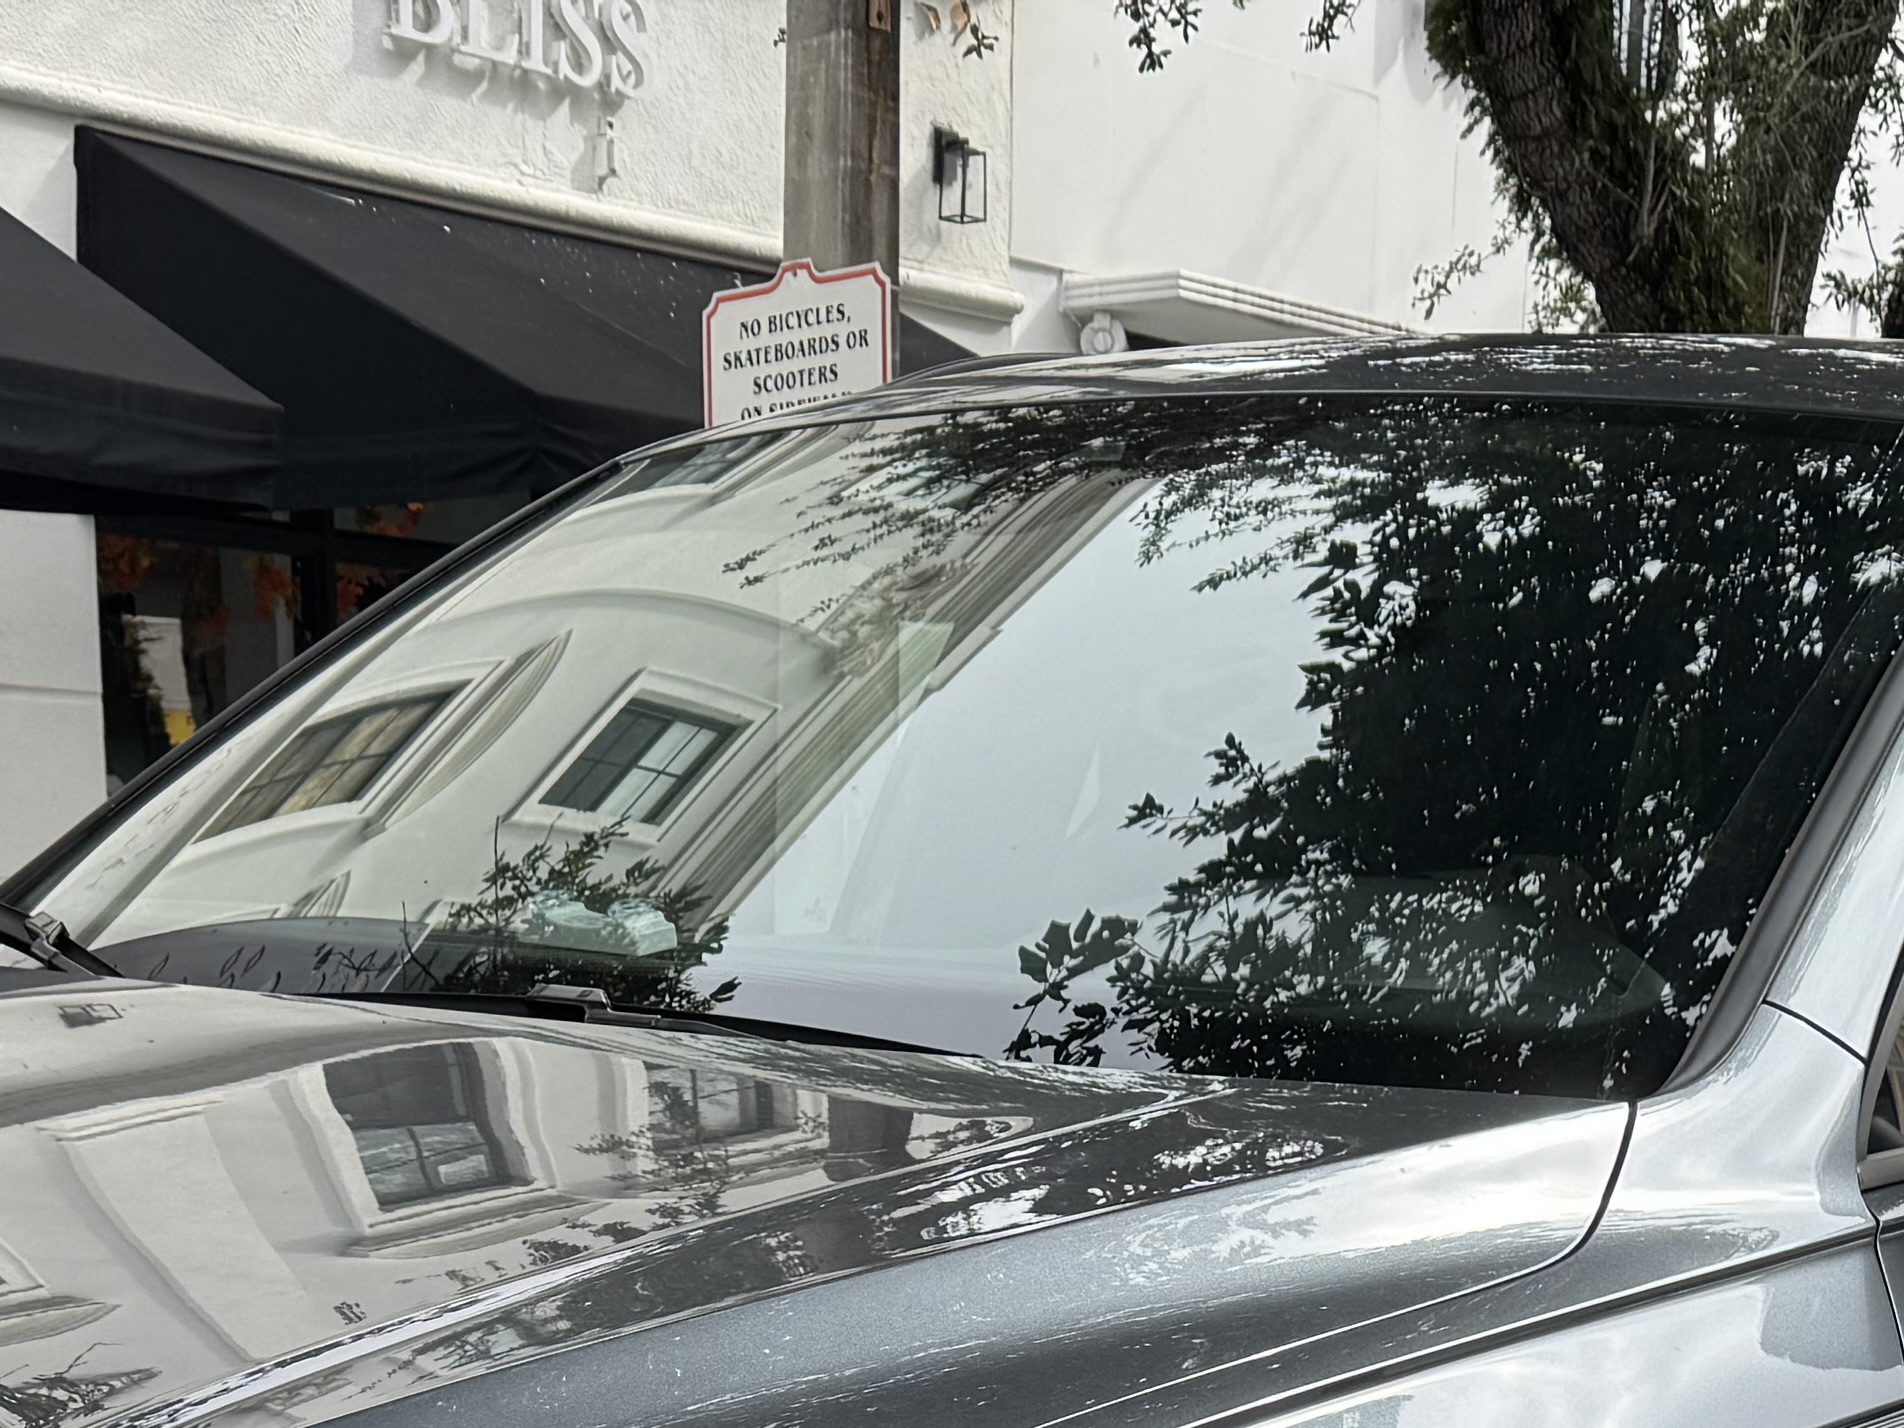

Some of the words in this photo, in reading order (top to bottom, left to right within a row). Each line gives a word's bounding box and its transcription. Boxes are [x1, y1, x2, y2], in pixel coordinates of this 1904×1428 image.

[738, 318, 761, 340] NO
[768, 303, 851, 333] BICYCLES,
[723, 333, 839, 370] SKATEBOARDS
[846, 328, 869, 350] OR
[753, 363, 838, 395] SCOOTERS
